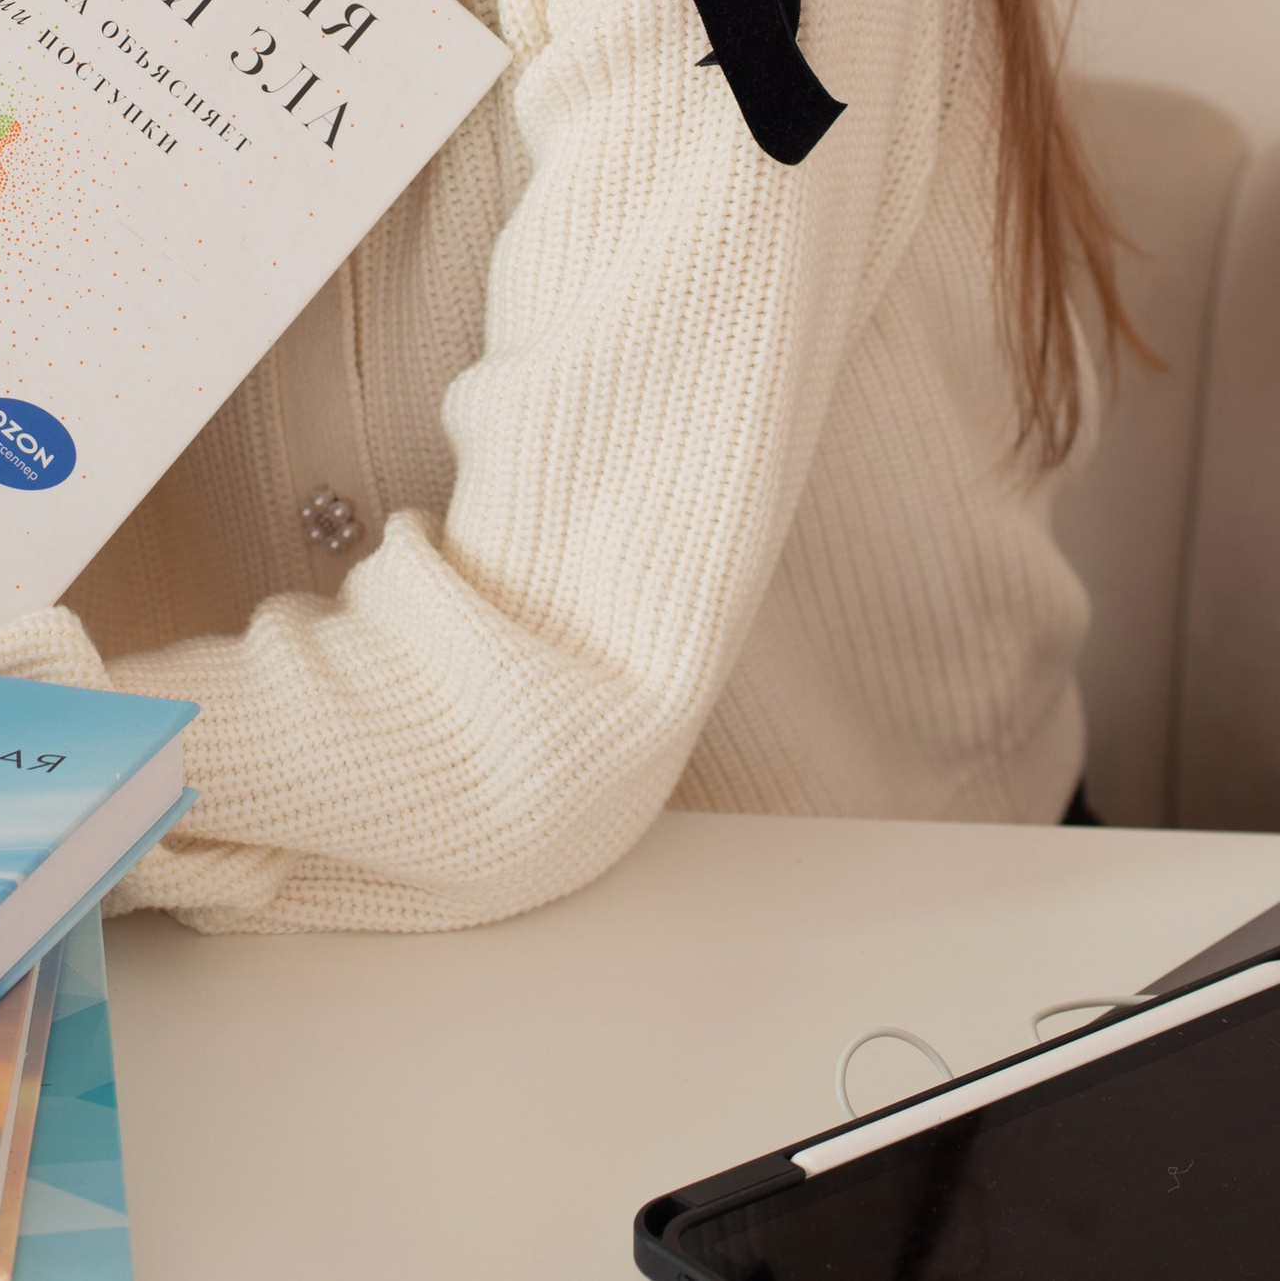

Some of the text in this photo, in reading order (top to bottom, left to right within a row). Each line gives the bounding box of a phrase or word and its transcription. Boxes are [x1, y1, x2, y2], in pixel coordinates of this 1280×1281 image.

[37, 29, 179, 155] ПОСТУПКИ
[100, 20, 253, 153] ОБЪЯСНЯЕТ
[230, 26, 350, 150] ЗЛА
